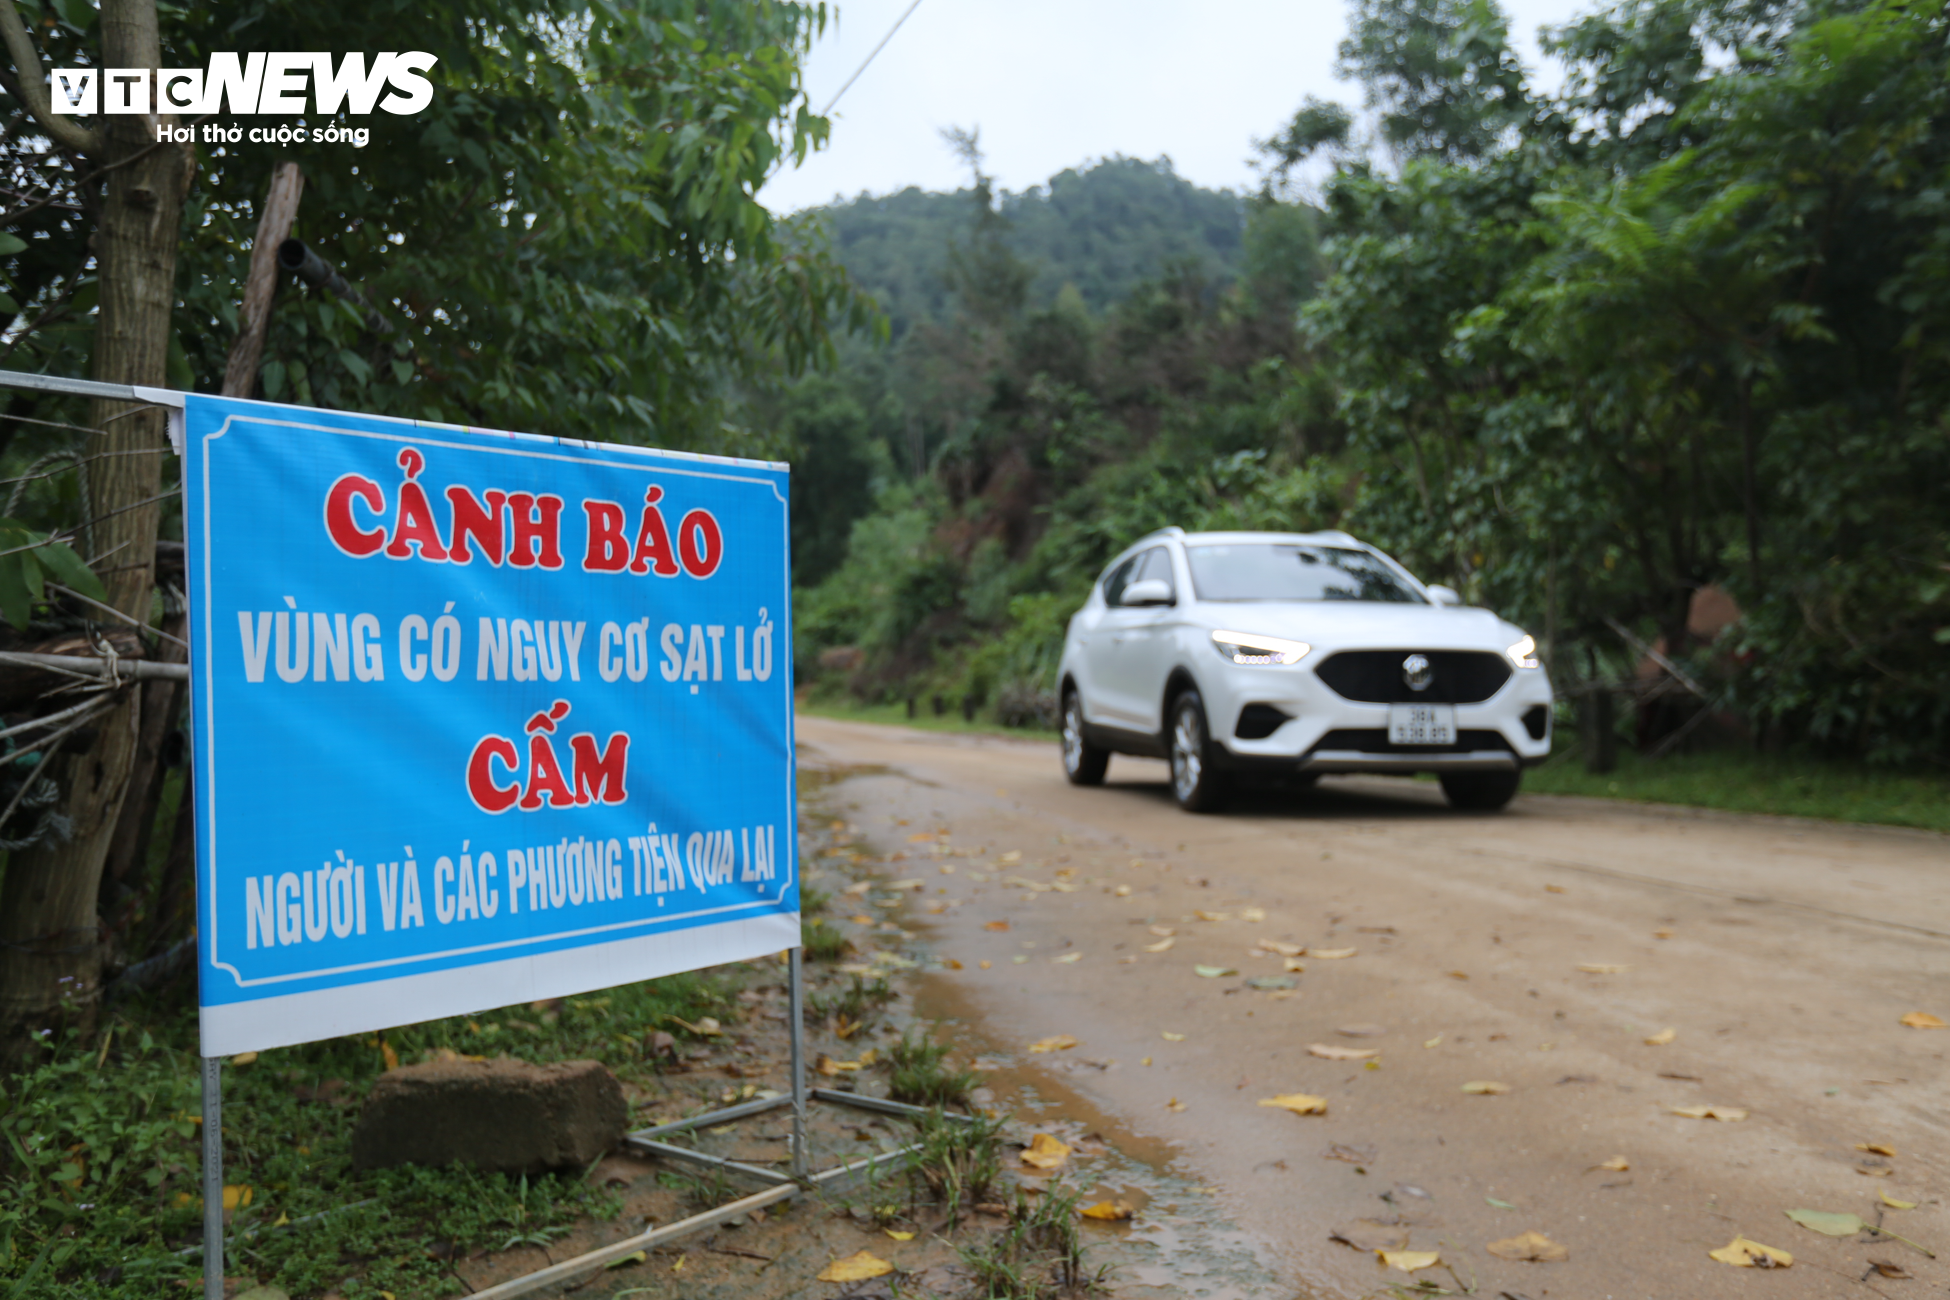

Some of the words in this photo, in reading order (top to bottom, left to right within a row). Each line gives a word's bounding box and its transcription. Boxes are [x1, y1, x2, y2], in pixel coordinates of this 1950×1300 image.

[324, 446, 564, 571] CẢNH
[581, 484, 724, 579] BÁO
[238, 596, 384, 683] VÙNG
[400, 601, 461, 682] CÓ
[476, 617, 586, 682] NGUY
[600, 617, 649, 682] CƠ
[661, 623, 724, 694] SẠT
[736, 607, 773, 682] LỞ
[466, 698, 630, 815] CẤM
[246, 849, 366, 949] NGƯỜI
[377, 845, 424, 931] VÀ
[434, 839, 499, 925] CÁC
[508, 836, 622, 914] PHƯƠNG
[629, 822, 685, 906] TIỆN
[686, 829, 734, 893] QUA
[741, 825, 775, 892] LẠI
